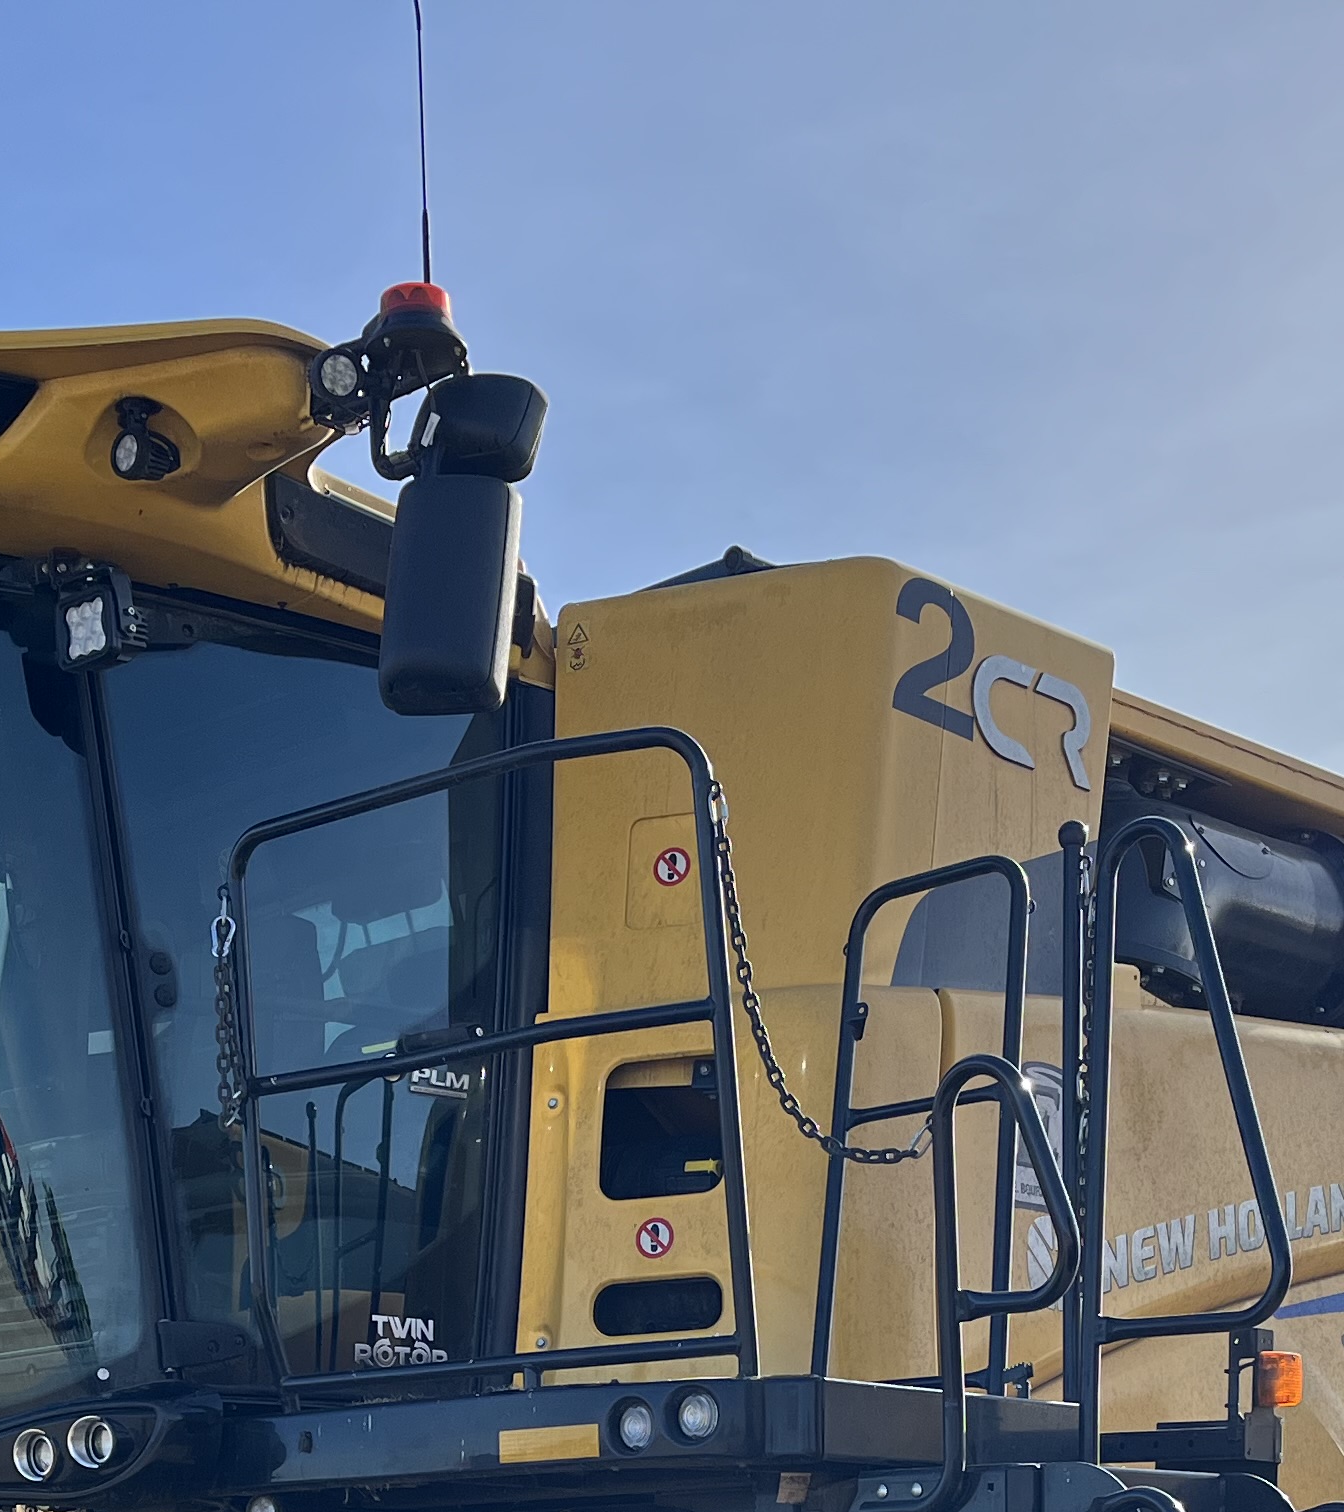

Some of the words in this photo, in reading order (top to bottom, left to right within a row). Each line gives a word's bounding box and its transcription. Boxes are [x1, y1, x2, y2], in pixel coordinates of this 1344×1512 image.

[892, 577, 975, 742] 2
[971, 654, 1091, 792] CR
[411, 1068, 470, 1090] PLM
[1102, 1214, 1196, 1293] NEW
[371, 1314, 434, 1342] TWIN
